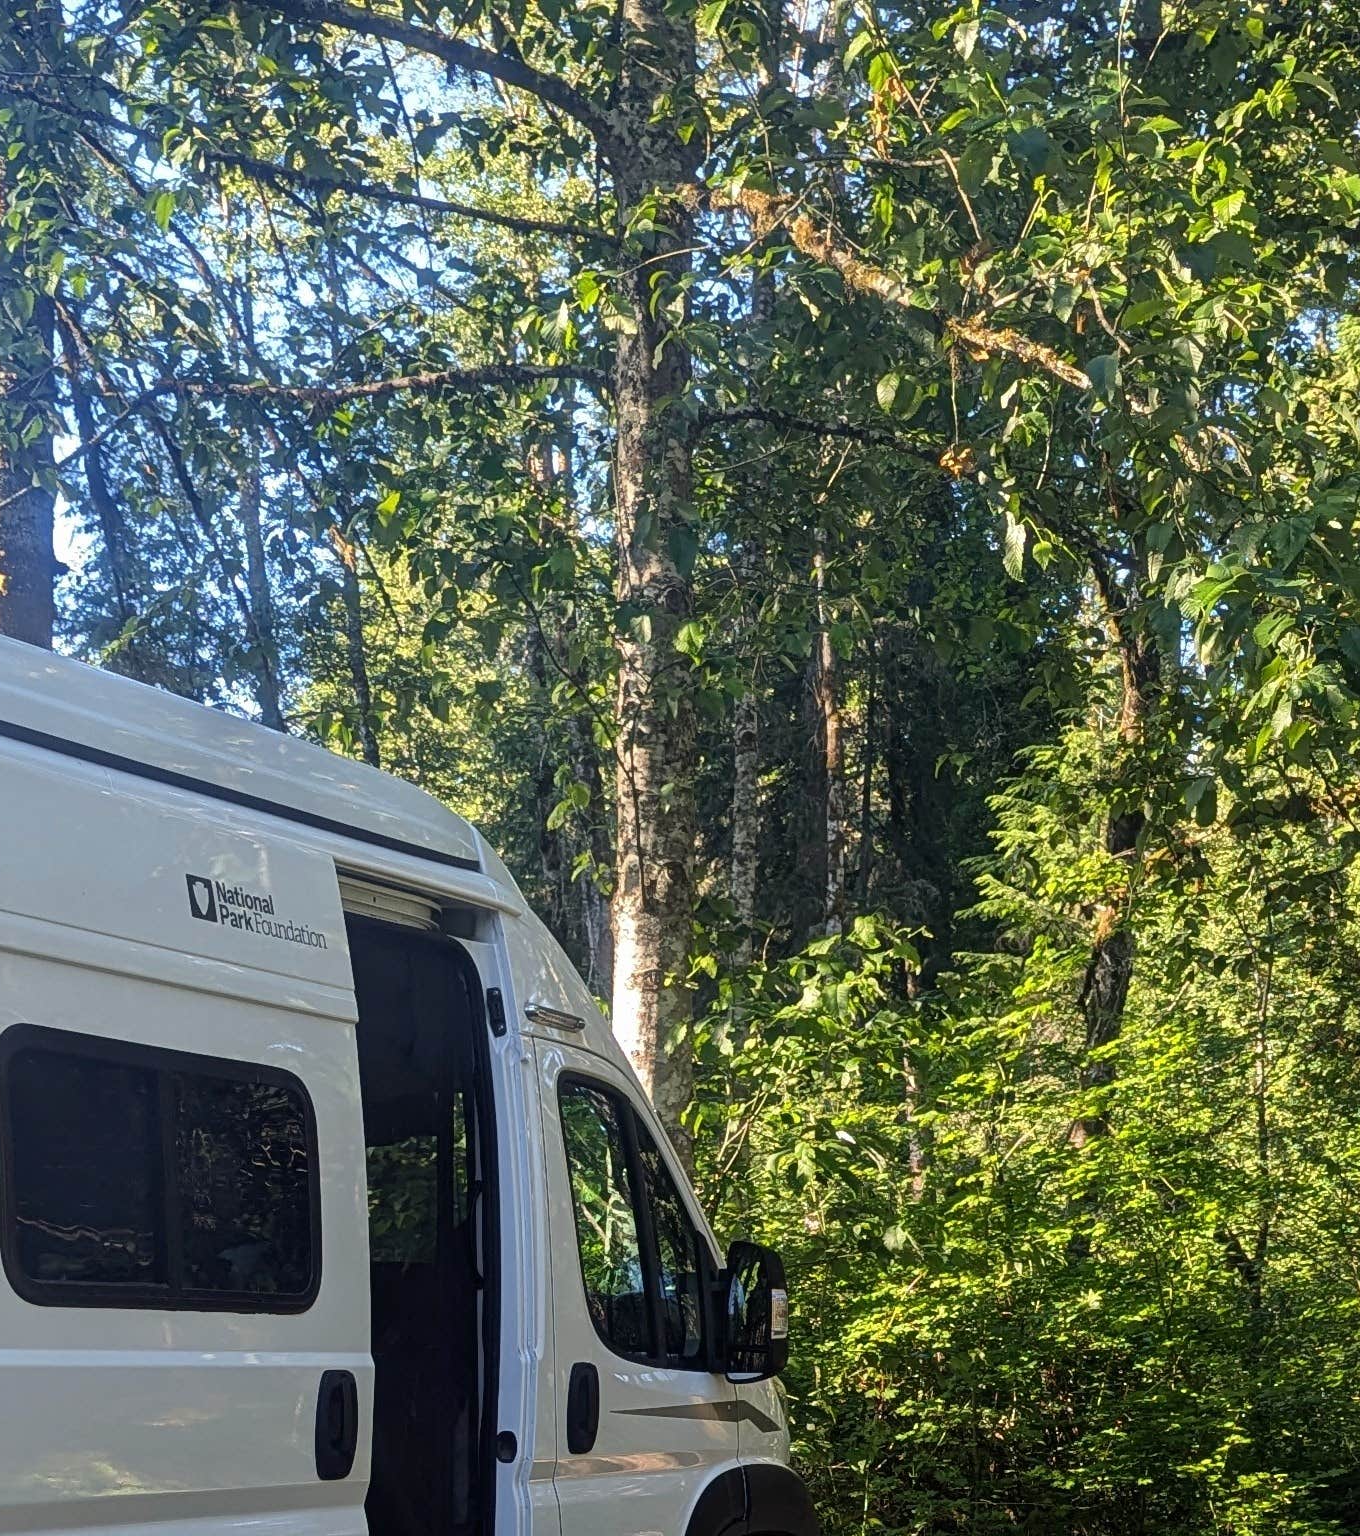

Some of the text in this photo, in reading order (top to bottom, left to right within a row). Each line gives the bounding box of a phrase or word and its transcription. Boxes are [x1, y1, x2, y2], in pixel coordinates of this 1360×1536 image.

[214, 881, 274, 915] National
[219, 904, 328, 949] Park Foundation
